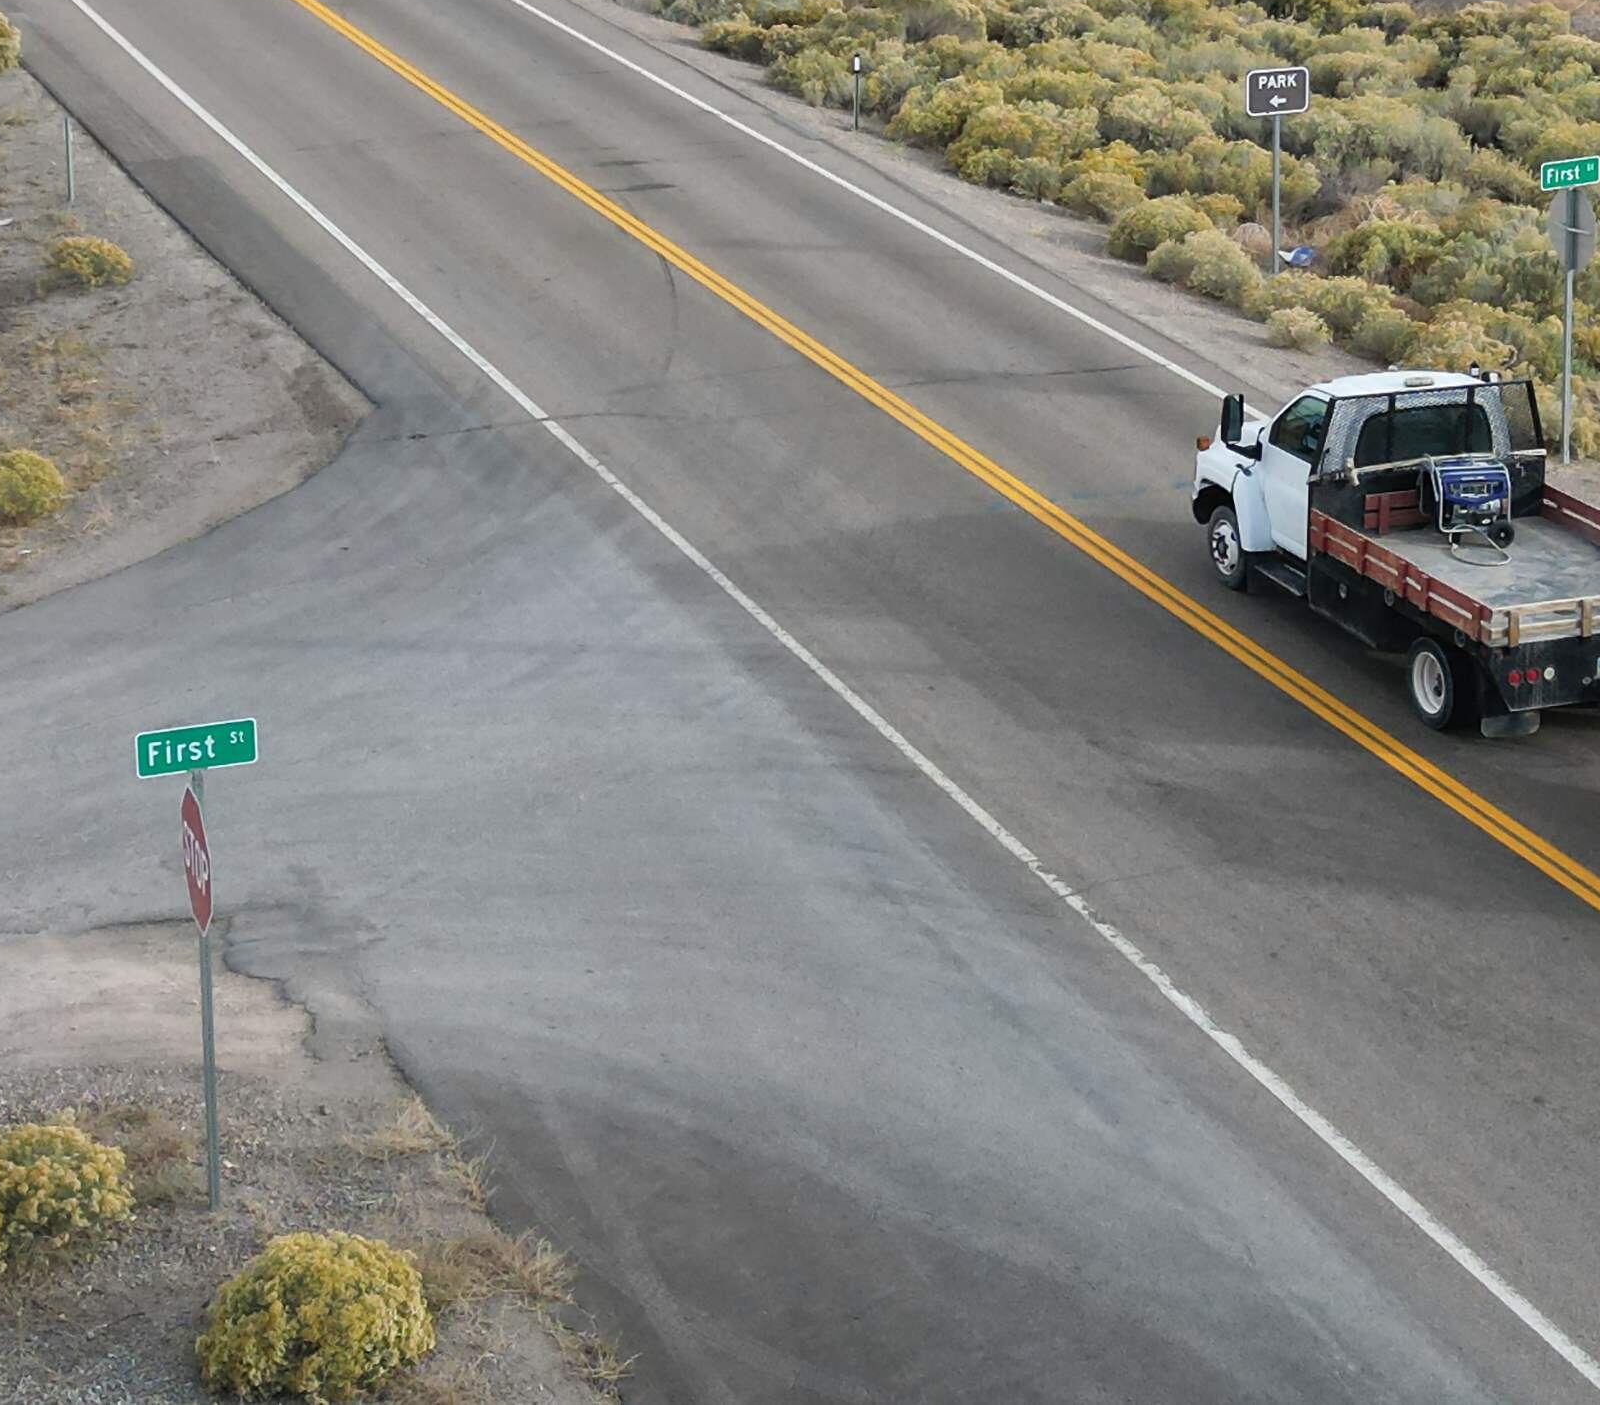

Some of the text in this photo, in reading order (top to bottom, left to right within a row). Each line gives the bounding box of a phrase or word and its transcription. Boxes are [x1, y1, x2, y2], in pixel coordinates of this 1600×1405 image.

[1258, 73, 1297, 89] PARK
[1546, 164, 1580, 184] First
[148, 730, 245, 767] First St
